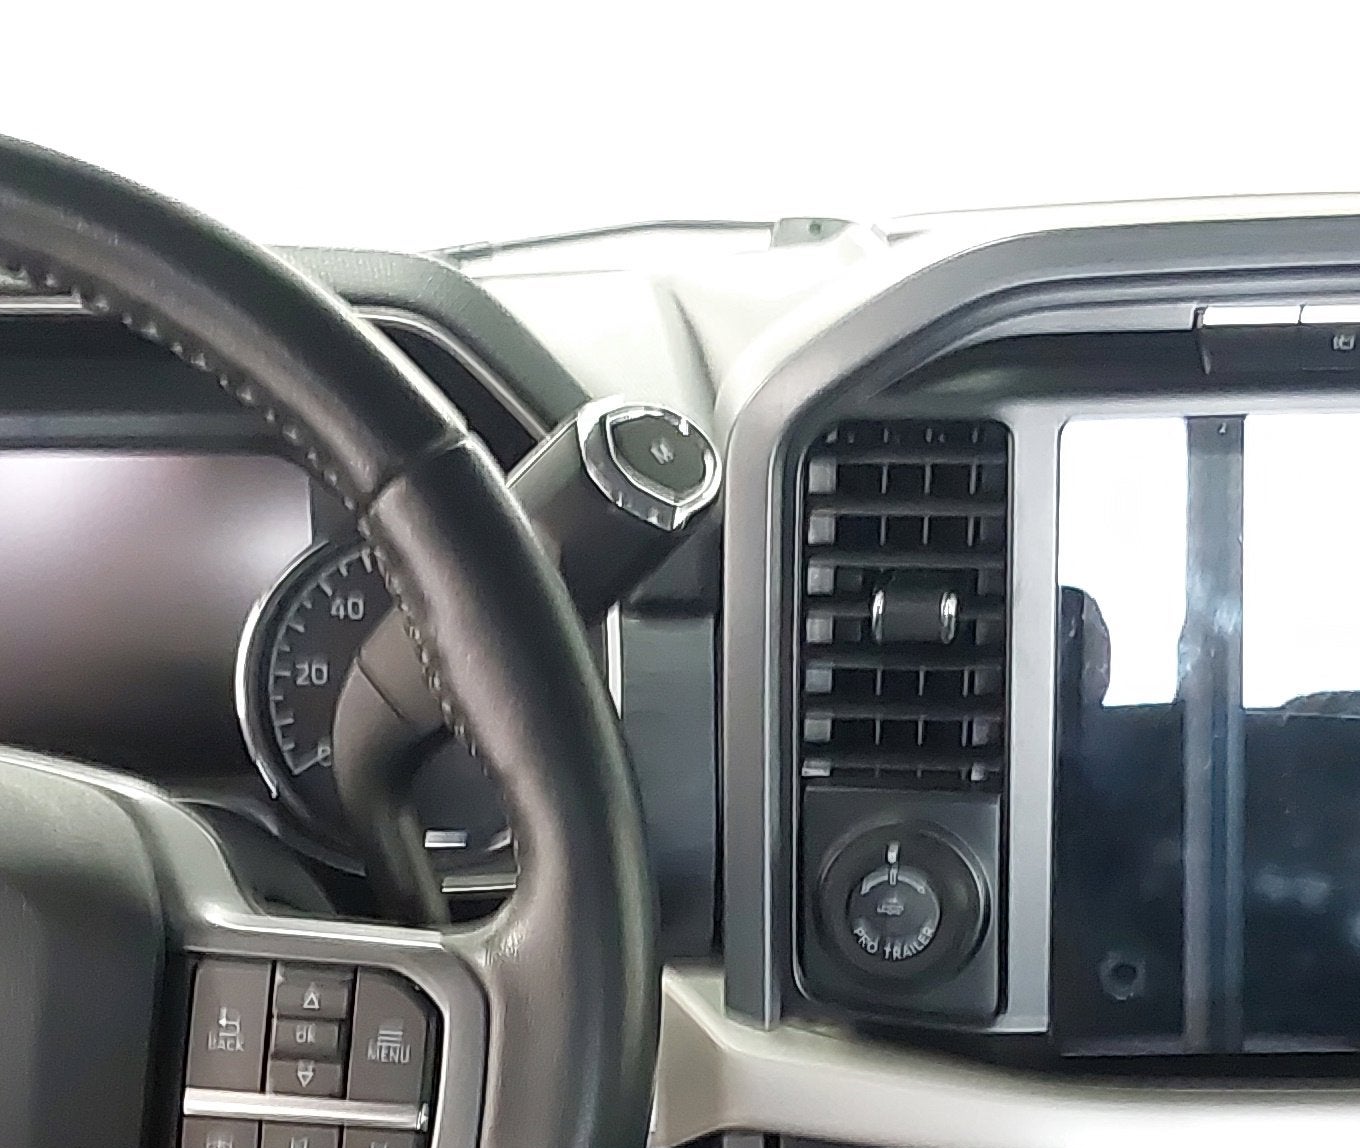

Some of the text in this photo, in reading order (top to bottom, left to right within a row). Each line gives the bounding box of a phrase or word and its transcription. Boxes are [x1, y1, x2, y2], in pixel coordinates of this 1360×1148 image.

[330, 597, 365, 622] 40
[295, 660, 329, 687] 20
[853, 923, 937, 961] PRO TRAILER
[207, 1032, 245, 1052] BACK
[367, 1040, 411, 1064] MENU
